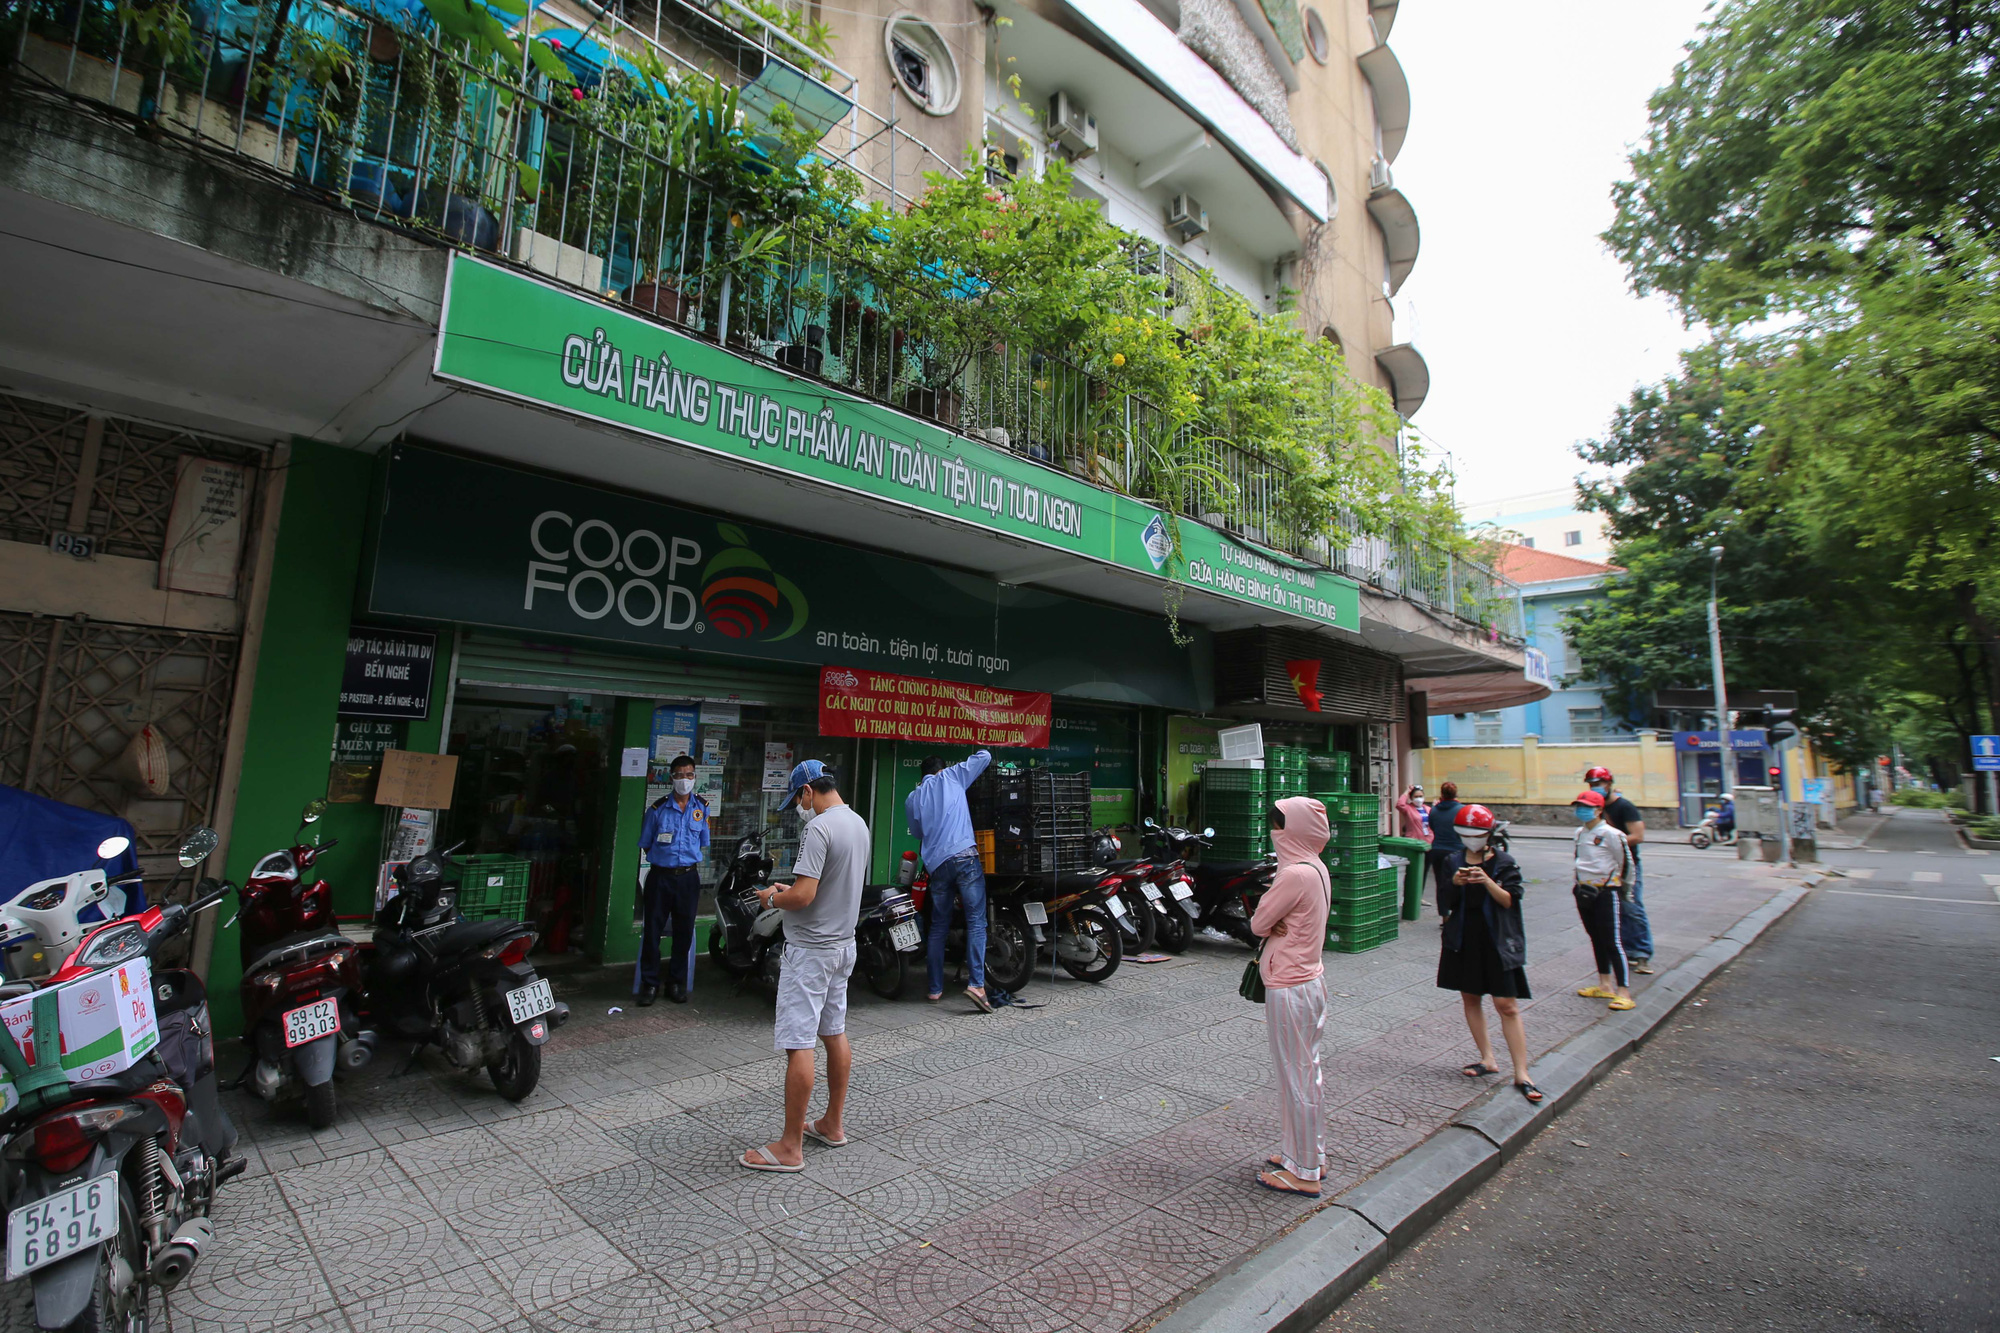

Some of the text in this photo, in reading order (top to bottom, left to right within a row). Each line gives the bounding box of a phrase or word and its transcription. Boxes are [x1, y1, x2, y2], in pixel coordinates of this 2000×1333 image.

[561, 327, 625, 403] CỬA
[629, 350, 710, 425] HÀNG
[714, 381, 782, 449] THỰC
[784, 405, 851, 468] PHẨM
[853, 430, 885, 478] AN
[888, 438, 938, 494] TOÀN
[941, 455, 977, 509] TIỆN
[979, 471, 1003, 519] LỢI
[1042, 496, 1082, 538] NGON
[57, 534, 91, 557] 95
[530, 510, 701, 581] CO.OP
[1189, 558, 1213, 585] CỬA
[1215, 567, 1246, 595] HÀNG
[1247, 577, 1271, 602] BÌNH
[1288, 591, 1302, 613] THỊ
[1297, 571, 1316, 589] NAM
[524, 560, 698, 631] FOOD
[346, 637, 365, 655] HỢP
[366, 637, 383, 655] TÁC
[407, 644, 420, 658] TM
[420, 645, 432, 659] DV
[816, 630, 838, 648] an
[841, 631, 879, 653] toàn
[889, 637, 918, 660] tiện
[922, 641, 938, 664] lợi
[946, 647, 973, 666] tươi
[977, 655, 1010, 674] ngon
[364, 658, 410, 680] BẾN NGHÉ
[869, 674, 895, 693] TĂNG
[339, 692, 348, 703] 95
[348, 693, 374, 705] PASTEUR
[825, 691, 848, 710] CÁC
[850, 696, 876, 712] NGUY
[910, 702, 924, 716] RO
[938, 705, 951, 719] AN
[990, 712, 1009, 724] SINH
[1010, 713, 1024, 724] LAO
[375, 723, 392, 735] XE
[854, 715, 867, 733] VÀ
[869, 719, 896, 735] THAM
[898, 721, 913, 736] GIA
[915, 719, 932, 737] CỦA
[934, 725, 947, 738] AN
[988, 729, 1007, 742] SINH
[897, 932, 917, 946] 9573
[513, 984, 543, 1005] 59-T1
[132, 996, 146, 1023] Pía
[291, 1003, 329, 1026] 59-C2
[513, 996, 551, 1021] 311.83
[289, 1016, 336, 1043] 993.03
[100, 1063, 111, 1072] C2
[25, 1184, 101, 1237] 54-L6
[24, 1213, 102, 1267] 6894
